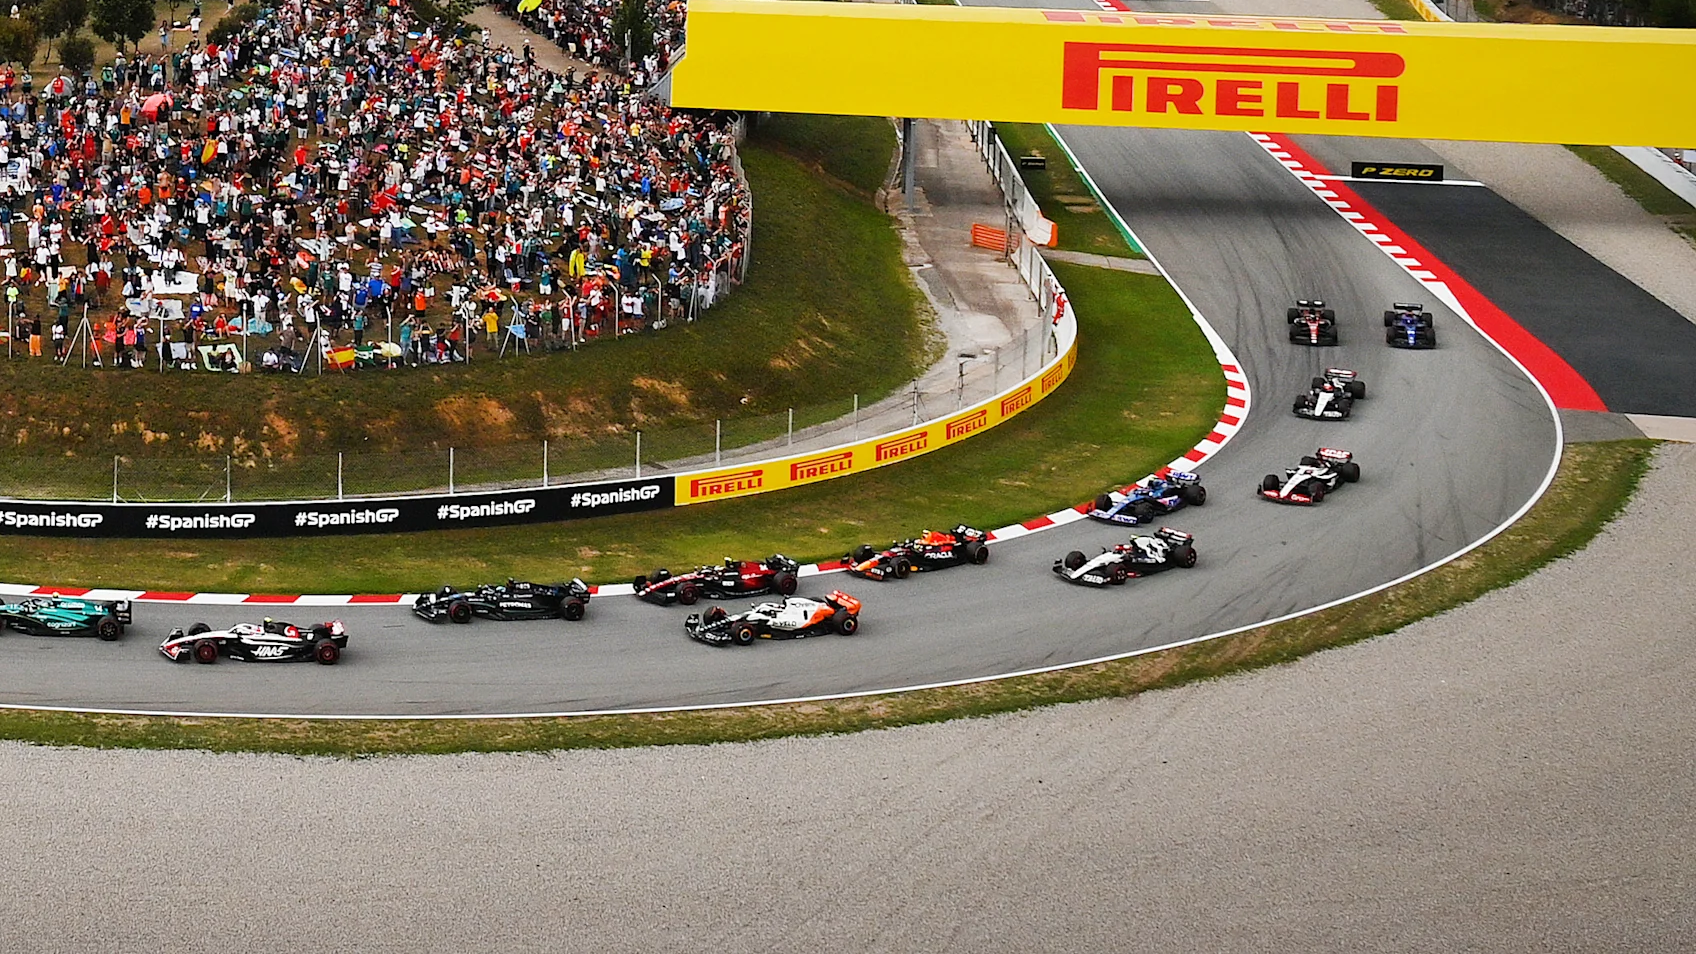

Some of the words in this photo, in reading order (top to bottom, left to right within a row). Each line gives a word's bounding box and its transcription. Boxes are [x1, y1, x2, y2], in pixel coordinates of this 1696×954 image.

[1062, 41, 1406, 123] PIRELLI
[1361, 166, 1377, 175] P
[1378, 167, 1435, 178] ZERO
[1001, 386, 1032, 417] PIRELLI
[946, 409, 988, 441] PIRELLI
[876, 430, 929, 462] PIRELLI
[790, 451, 853, 482] PIRELLI
[571, 484, 660, 508] #SpanishGP
[690, 469, 764, 498] PIRELLI
[146, 513, 256, 531] #SpanishGP
[295, 508, 400, 528] #SpanishGP
[437, 498, 536, 521] #SpanishGP
